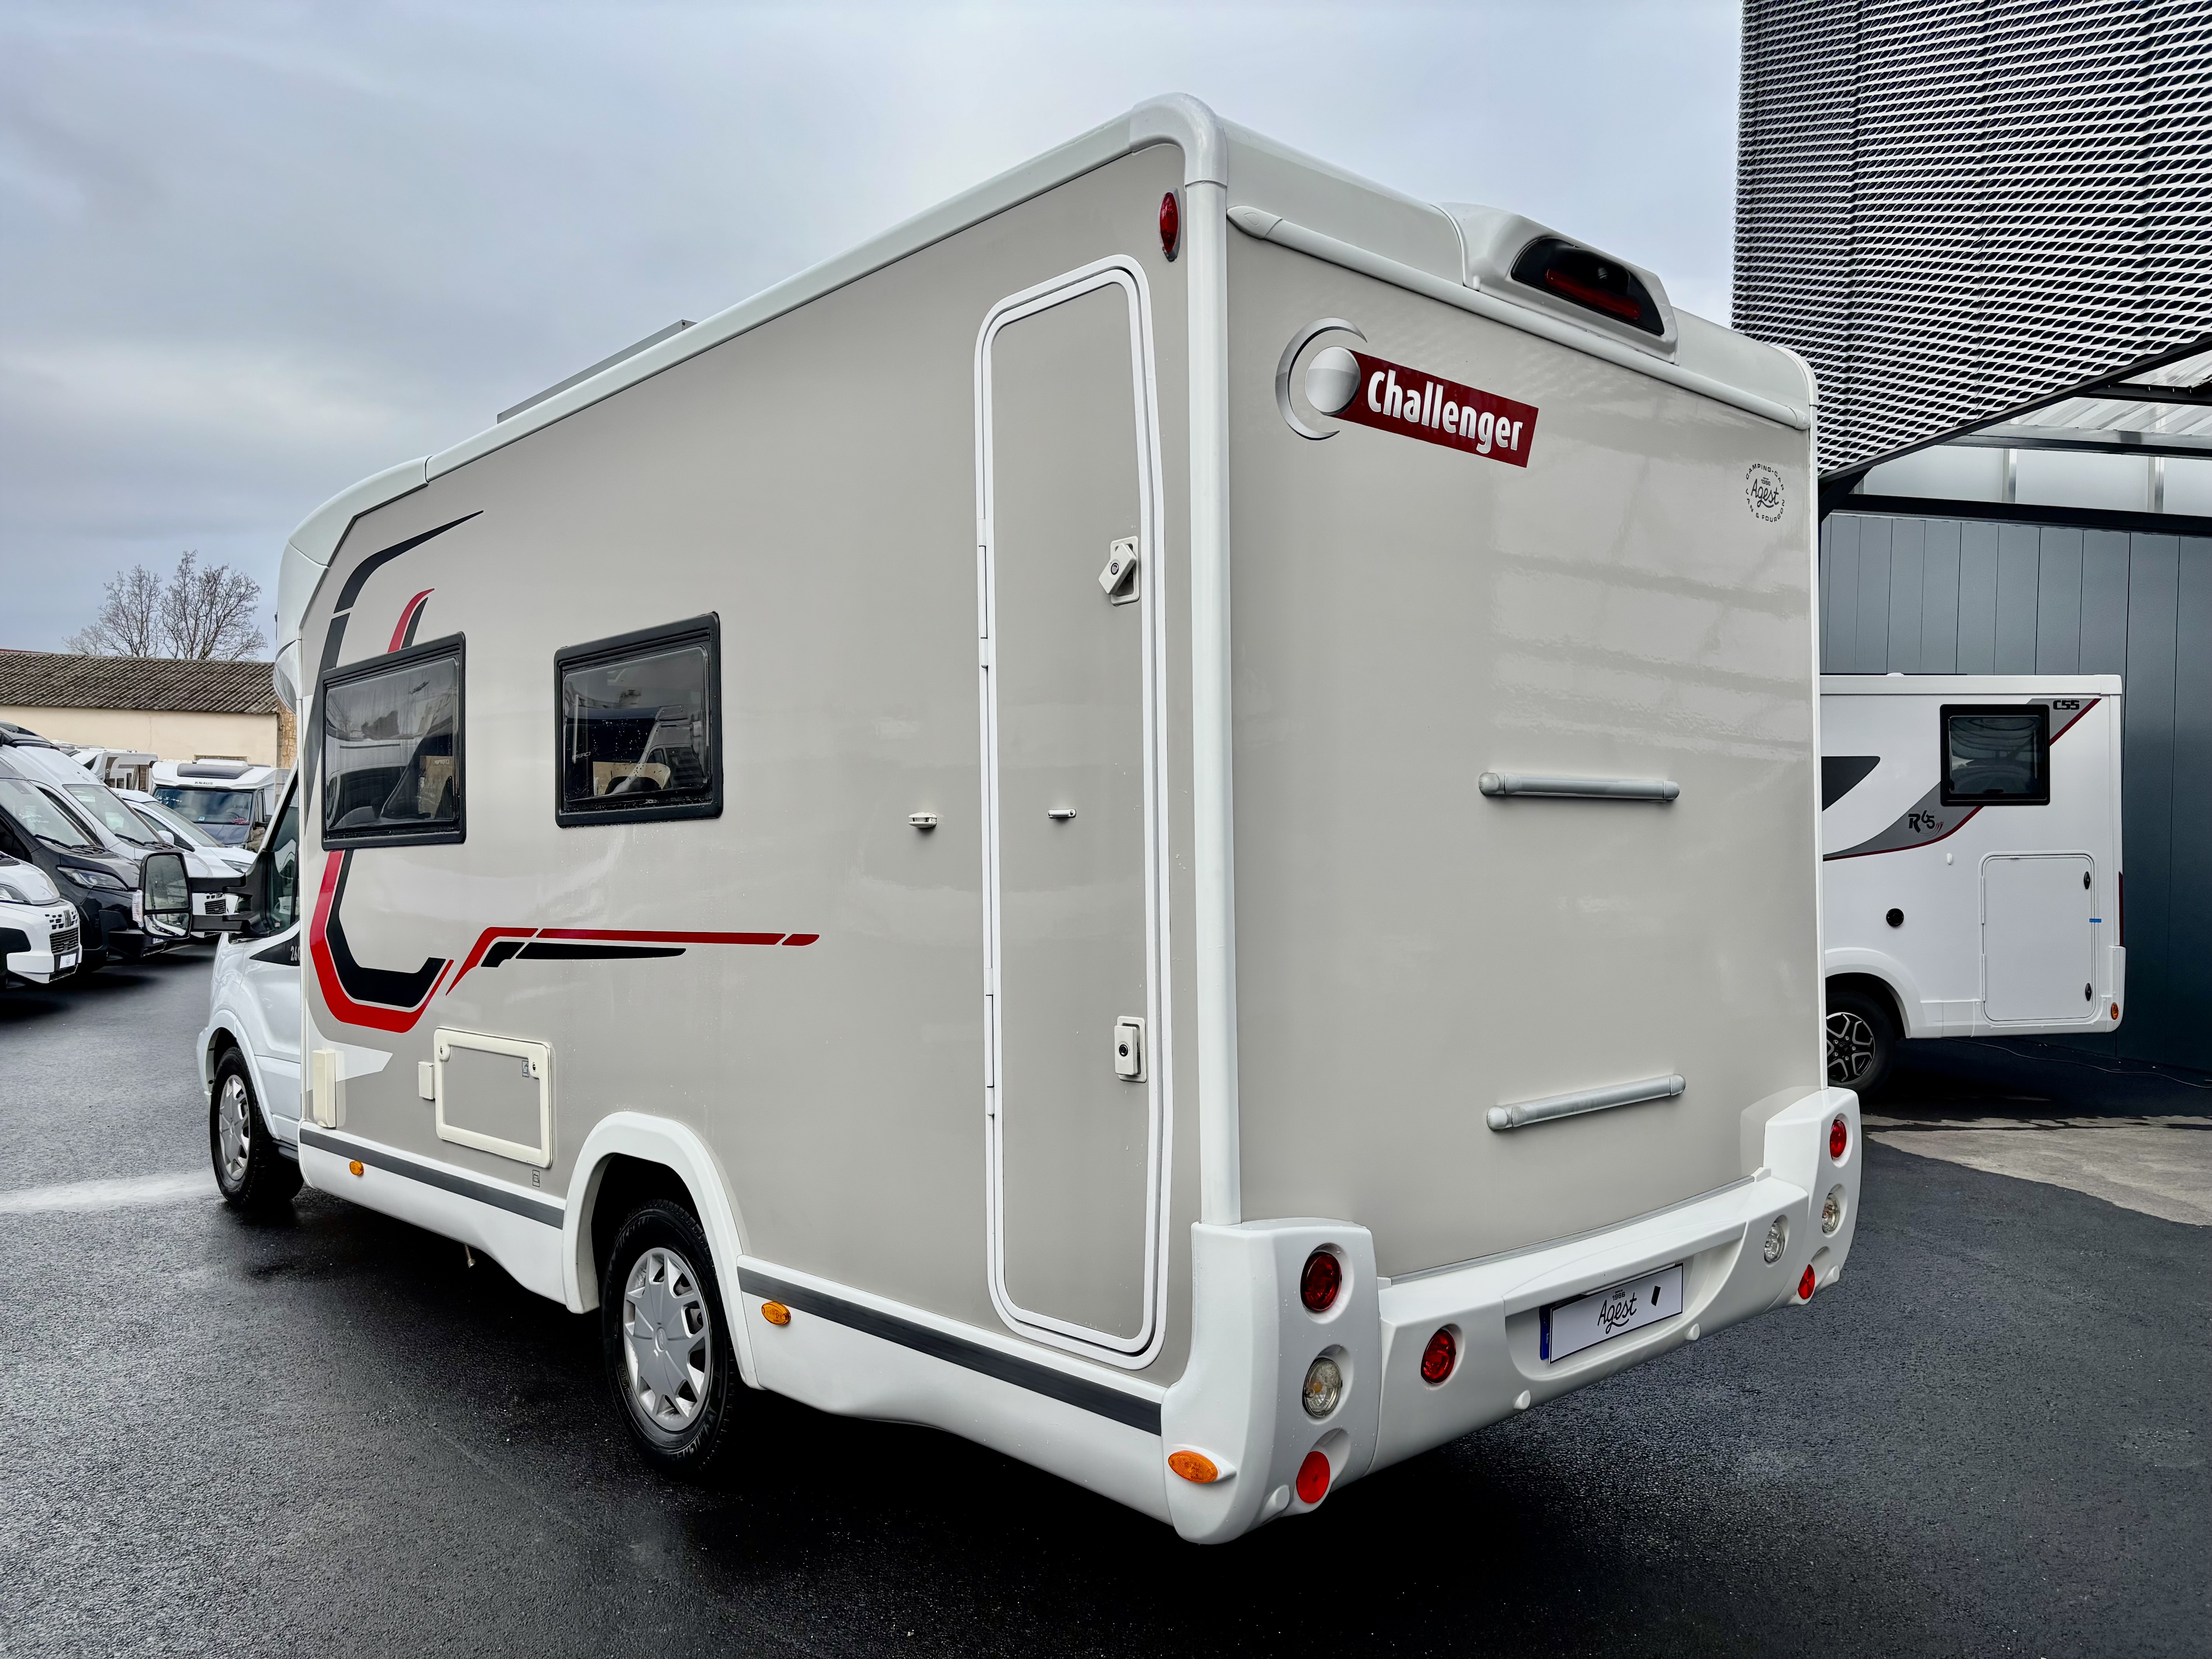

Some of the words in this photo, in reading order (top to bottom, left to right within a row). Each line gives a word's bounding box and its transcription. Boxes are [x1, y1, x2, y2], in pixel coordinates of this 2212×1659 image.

[1367, 369, 1523, 454] Challenger
[1750, 478, 1779, 508] Agest
[2053, 700, 2080, 710] C55
[1612, 1291, 1625, 1301] 1966
[1597, 1292, 1637, 1334] Agest
